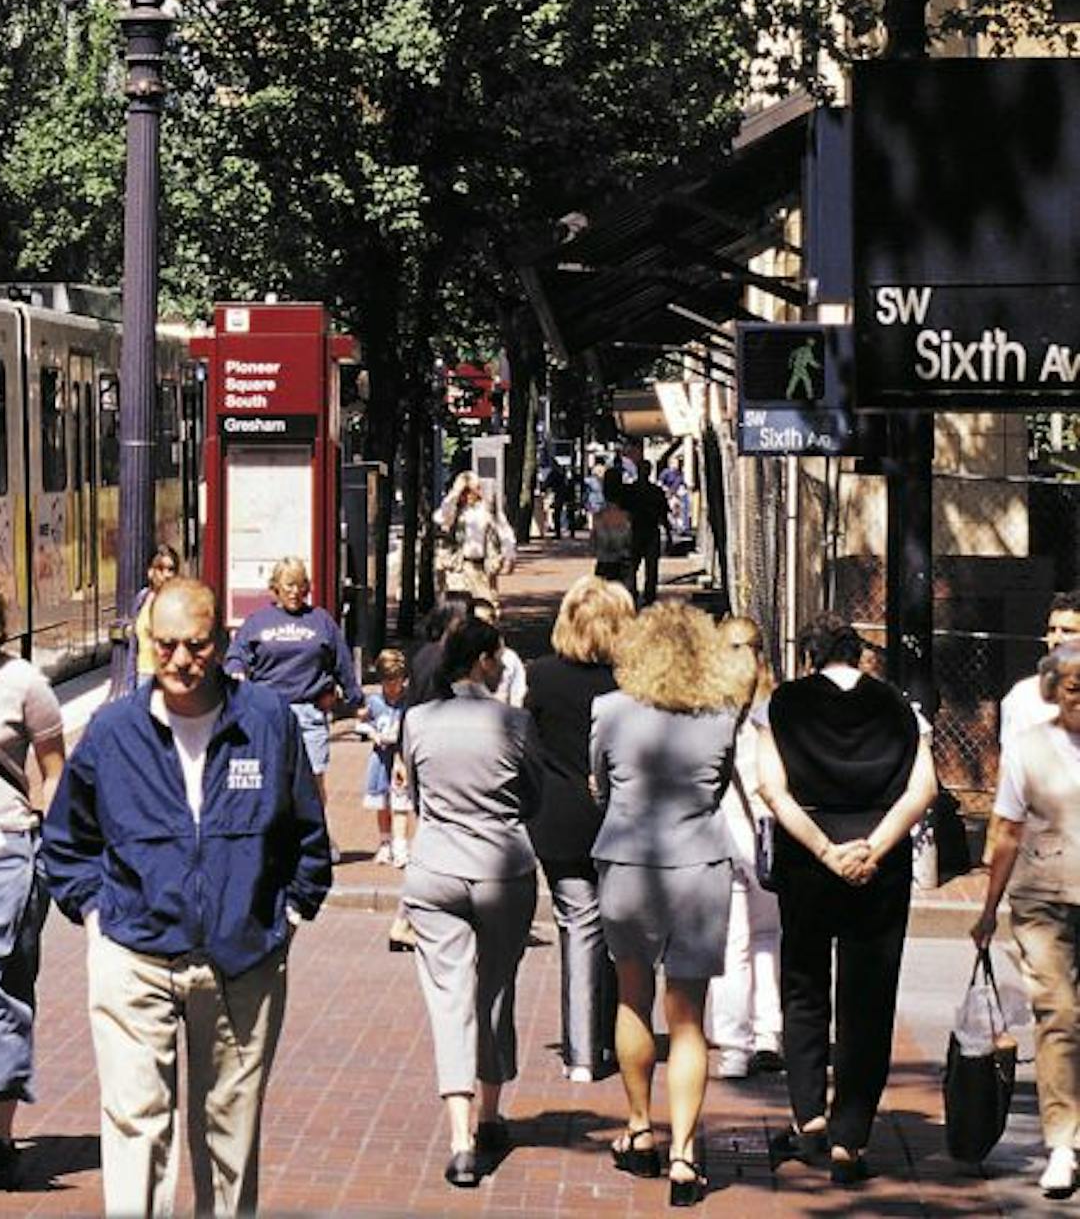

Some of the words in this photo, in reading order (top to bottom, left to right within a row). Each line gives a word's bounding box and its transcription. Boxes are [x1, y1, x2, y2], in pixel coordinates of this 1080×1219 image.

[876, 286, 932, 325] SW
[915, 327, 1027, 382] Sixth
[224, 361, 281, 374] Pioneer
[224, 377, 277, 393] Square
[224, 394, 267, 408] South
[223, 417, 287, 432] Gresham
[744, 410, 767, 427] SW
[760, 427, 803, 449] Sixth
